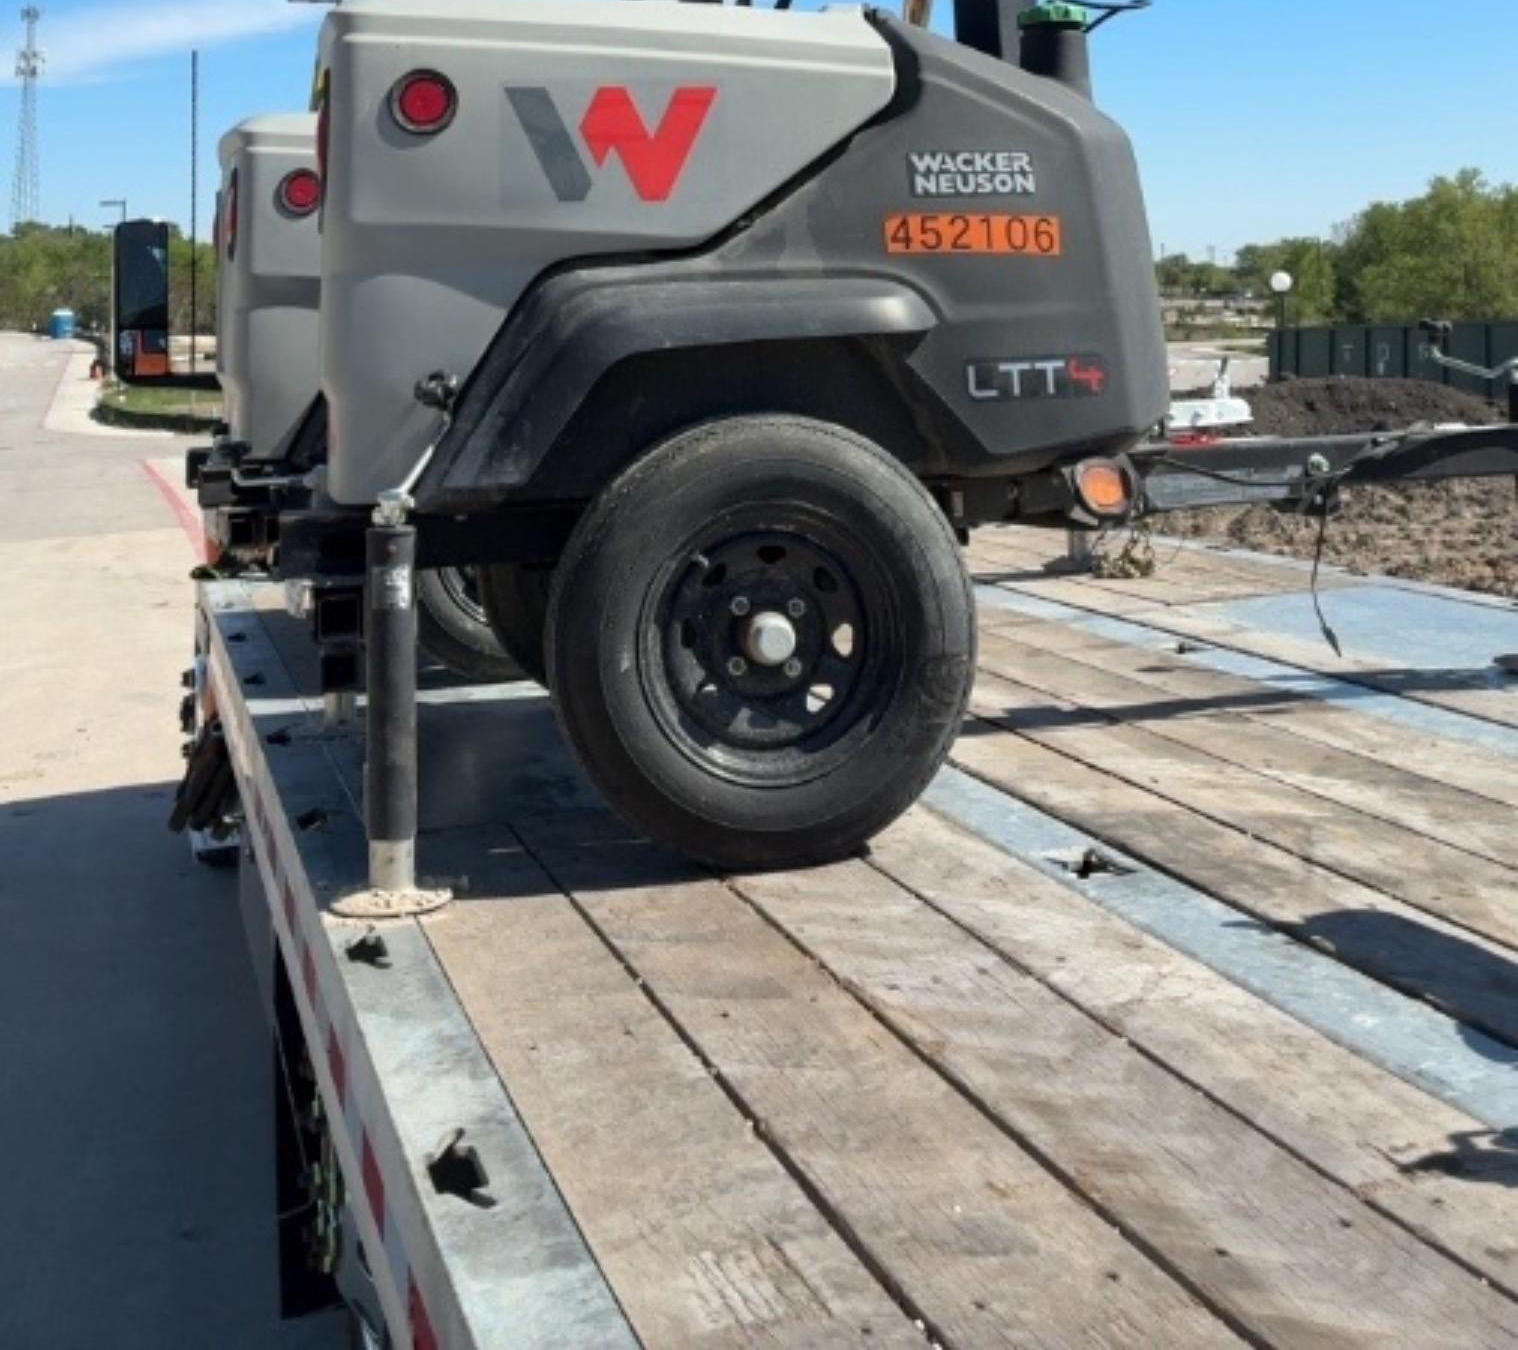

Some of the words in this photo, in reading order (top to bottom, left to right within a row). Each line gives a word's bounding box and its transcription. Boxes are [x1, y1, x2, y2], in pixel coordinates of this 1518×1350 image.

[911, 152, 1032, 173] WACKER
[914, 173, 1036, 194] NEUSON
[890, 215, 1055, 252] 452106
[967, 359, 1105, 398] LTT4
